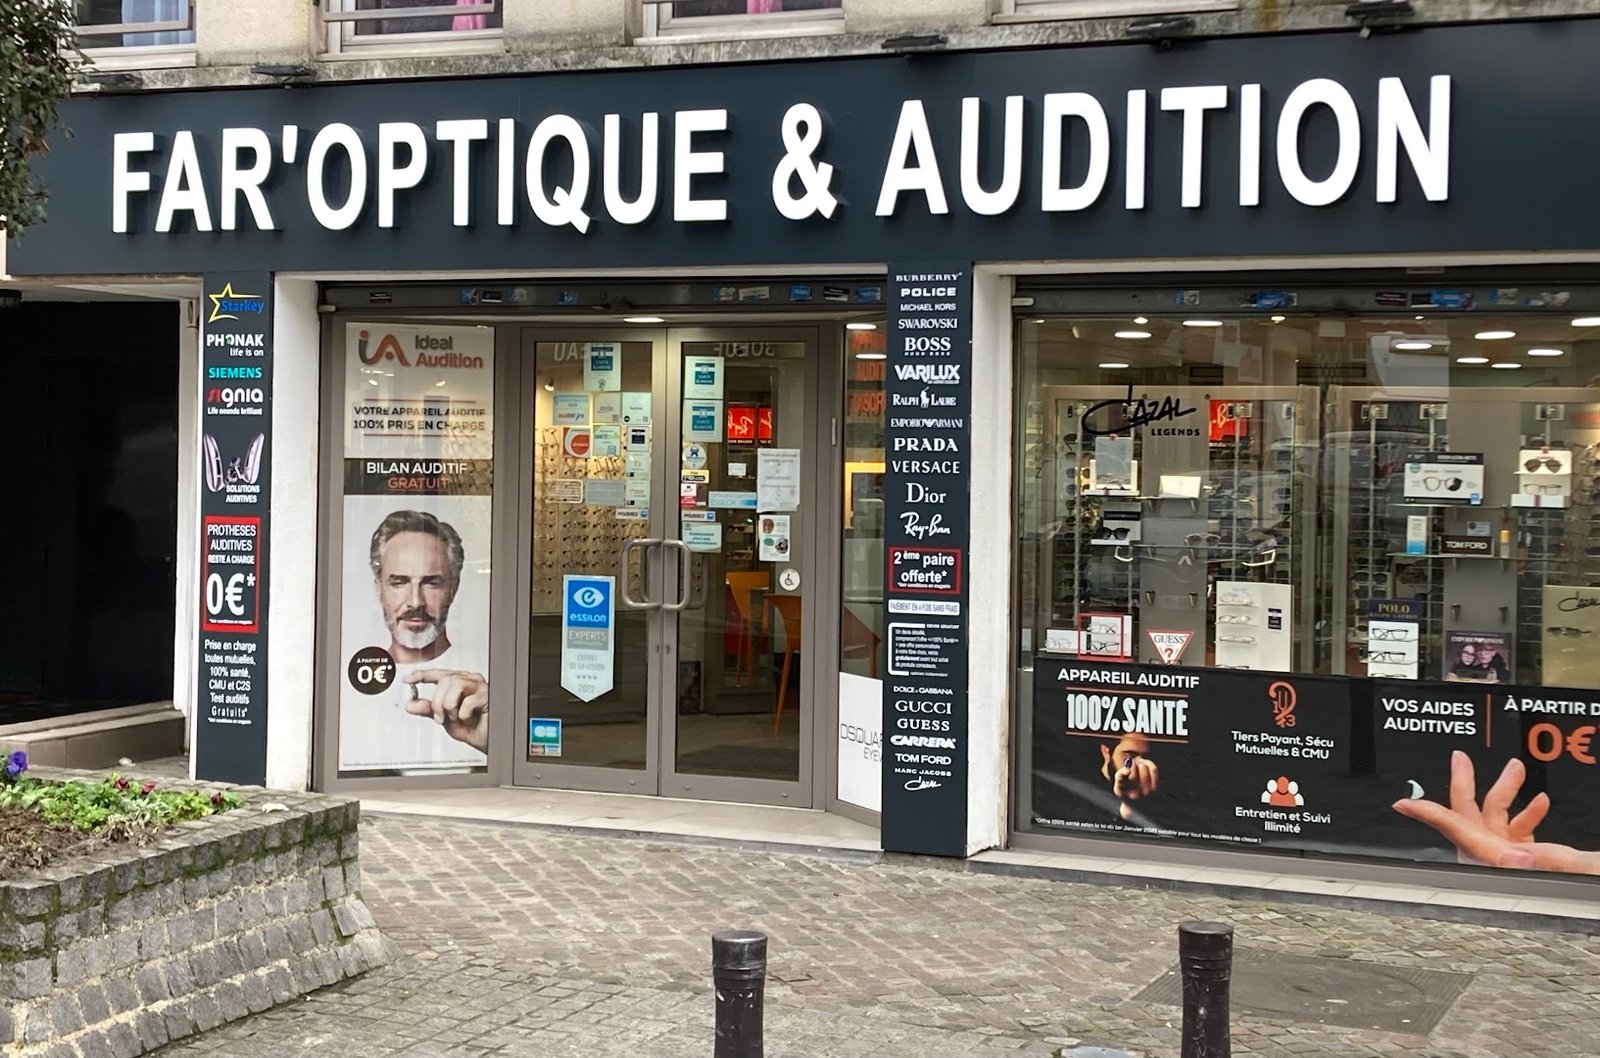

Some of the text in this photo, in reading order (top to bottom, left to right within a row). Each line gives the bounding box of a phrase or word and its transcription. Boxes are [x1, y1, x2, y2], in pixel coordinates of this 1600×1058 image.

[112, 74, 1452, 235] FAR'OPTIQUE & AUDITION
[896, 272, 960, 282] BURBERRY
[900, 287, 957, 297] POLICE
[220, 298, 265, 314] Starkey
[900, 303, 957, 312] MICHAEL KORS
[898, 318, 958, 329] SWAROVSKI
[415, 335, 453, 351] Ideal
[905, 336, 951, 352] BOSS
[230, 347, 264, 357] life is on
[416, 352, 484, 369] Audition
[208, 366, 263, 379] SIEMENS
[894, 364, 961, 383] VARILUX
[207, 387, 264, 407] signia
[207, 406, 218, 415] Life
[354, 406, 486, 417] VOTRE APPAREIL AUDITIF
[353, 419, 485, 431] 100% PRIS EN CHARGE
[1151, 428, 1200, 437] LEGENDS
[893, 437, 958, 452] PRADA
[366, 462, 468, 475] BILAN AUDITIF
[892, 460, 961, 474] VERSACE
[226, 484, 260, 493] SOLUTIONS
[387, 477, 448, 489] GRATUIT
[225, 494, 258, 503] AUDITIVES
[905, 482, 947, 504] Dior
[207, 524, 256, 537] PROTHESES
[210, 539, 252, 551] AUDITIVES
[1446, 540, 1488, 550] TOM FORD
[207, 554, 226, 564] RESTE
[231, 555, 255, 565] CHARGE
[922, 552, 955, 569] paire
[1378, 603, 1411, 614] POLO
[569, 630, 607, 641] EXPERTS
[1153, 634, 1185, 645] GUESS
[204, 639, 257, 654] Prise en charge
[210, 666, 229, 677] 100%
[209, 679, 251, 691] CMU et C2S
[1057, 668, 1200, 689] APPAREIL AUDITIF
[578, 684, 596, 694] 2022
[893, 686, 915, 694] DOLCE
[918, 687, 954, 696] GABBANA
[210, 692, 225, 703] Test
[895, 700, 952, 714] GUCCI
[1382, 698, 1475, 716] VOS AIDES
[1504, 695, 1518, 711] À
[1521, 699, 1586, 715] PARTIR
[1066, 693, 1120, 732] 100%
[896, 718, 950, 731] GUESS
[1384, 717, 1477, 735] AUDITIVES
[890, 735, 956, 749] CARRERA
[1231, 730, 1259, 742] Tiers
[1305, 735, 1334, 748] Sécu
[1235, 743, 1330, 760] Mutuelles & CMU
[895, 753, 952, 765] TOM FORD
[918, 769, 952, 777] JACOBS
[1235, 807, 1331, 824] Entretien et Suivi
[1264, 821, 1301, 834] Illimité
